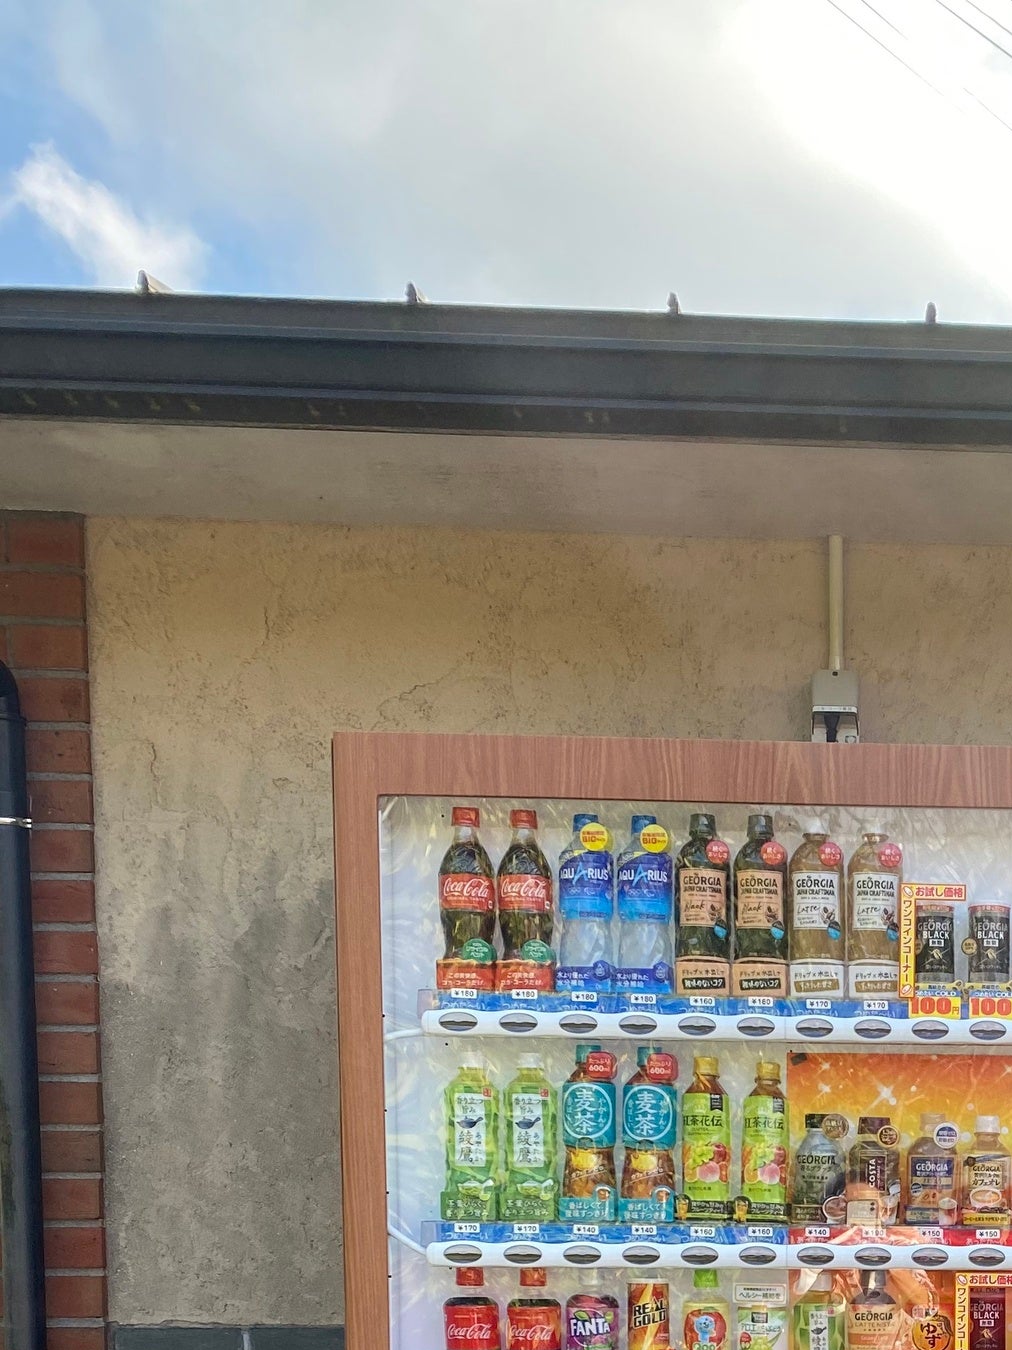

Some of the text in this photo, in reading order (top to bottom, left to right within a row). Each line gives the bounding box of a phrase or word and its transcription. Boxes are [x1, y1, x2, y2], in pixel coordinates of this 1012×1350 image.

[561, 862, 608, 886] AQUARIUS
[620, 863, 667, 887] AQUARIUS
[443, 878, 489, 898] Coca-Cola
[501, 878, 547, 898] Coca-Cola
[915, 887, 963, 897] お試し価格
[903, 900, 912, 982] ワンコインコーナー
[923, 931, 949, 939] BLACK
[977, 931, 1004, 939] BLACK
[910, 997, 959, 1015] 100円
[574, 1089, 598, 1134] 麦茶
[633, 1092, 659, 1136] 麦茶
[683, 1115, 723, 1128] 紅茶花伝
[745, 1117, 784, 1131] 紅茶花伝
[458, 1132, 475, 1164] 綾鷹
[517, 1132, 532, 1164] 綾鷹
[797, 1155, 836, 1165] GEORGIA
[916, 1163, 948, 1172] GEORGIA
[868, 1158, 876, 1188] COSTA
[633, 1297, 666, 1317] REAL
[970, 1303, 1003, 1312] GEORGIA
[973, 1311, 1000, 1320] BLACK
[633, 1310, 666, 1328] GOLD
[854, 1312, 893, 1321] GEORGIA
[448, 1323, 492, 1340] Coca-Cola
[510, 1325, 554, 1341] Coca-Cola
[570, 1318, 611, 1337] FANTA
[920, 1322, 941, 1349] ゆず
